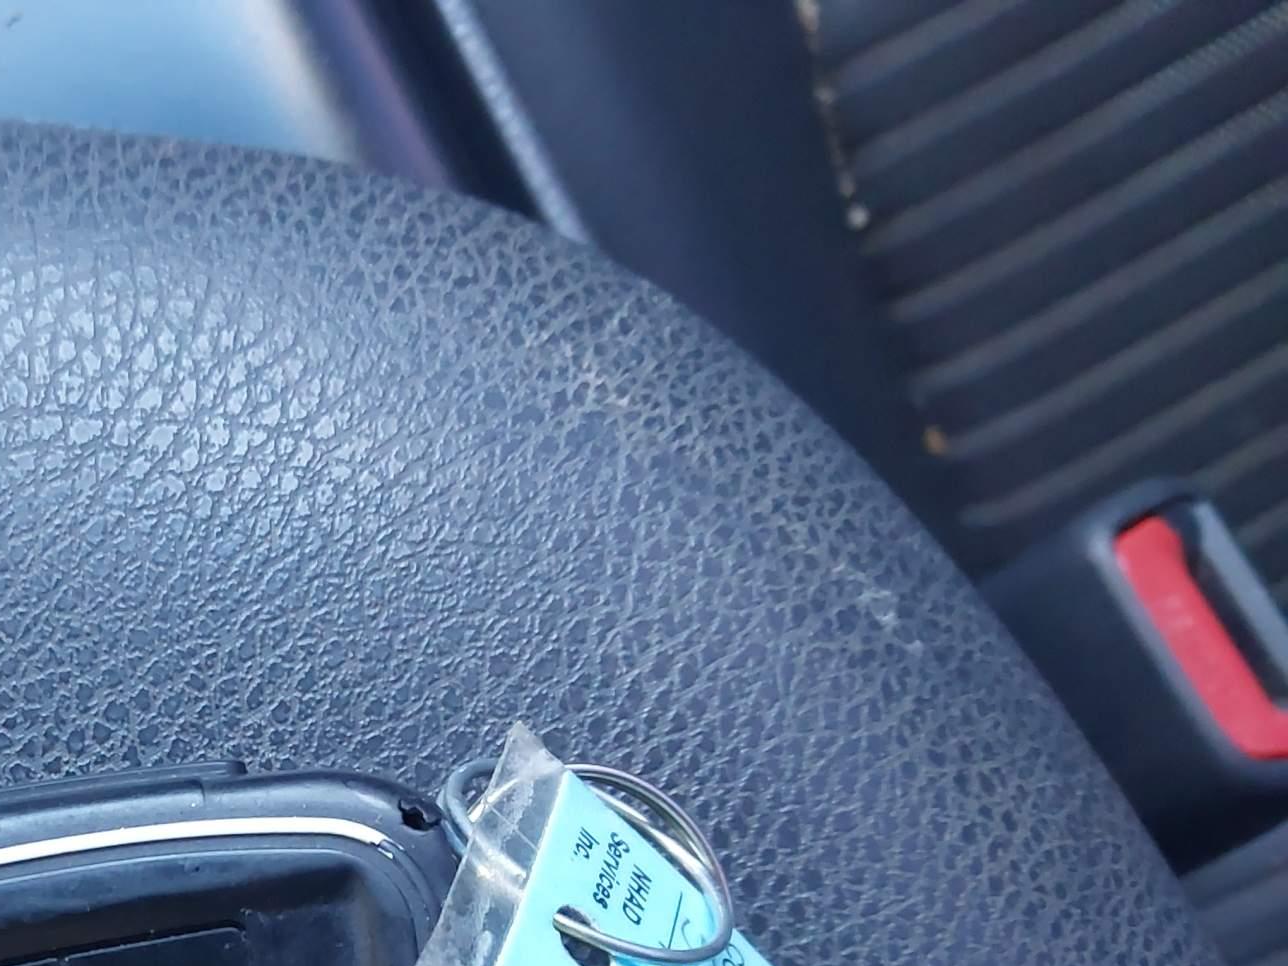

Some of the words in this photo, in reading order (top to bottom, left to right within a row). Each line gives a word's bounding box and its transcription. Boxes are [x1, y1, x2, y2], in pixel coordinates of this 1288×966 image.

[573, 826, 600, 860] Inc.
[593, 831, 630, 910] Services
[622, 865, 652, 926] NHAD
